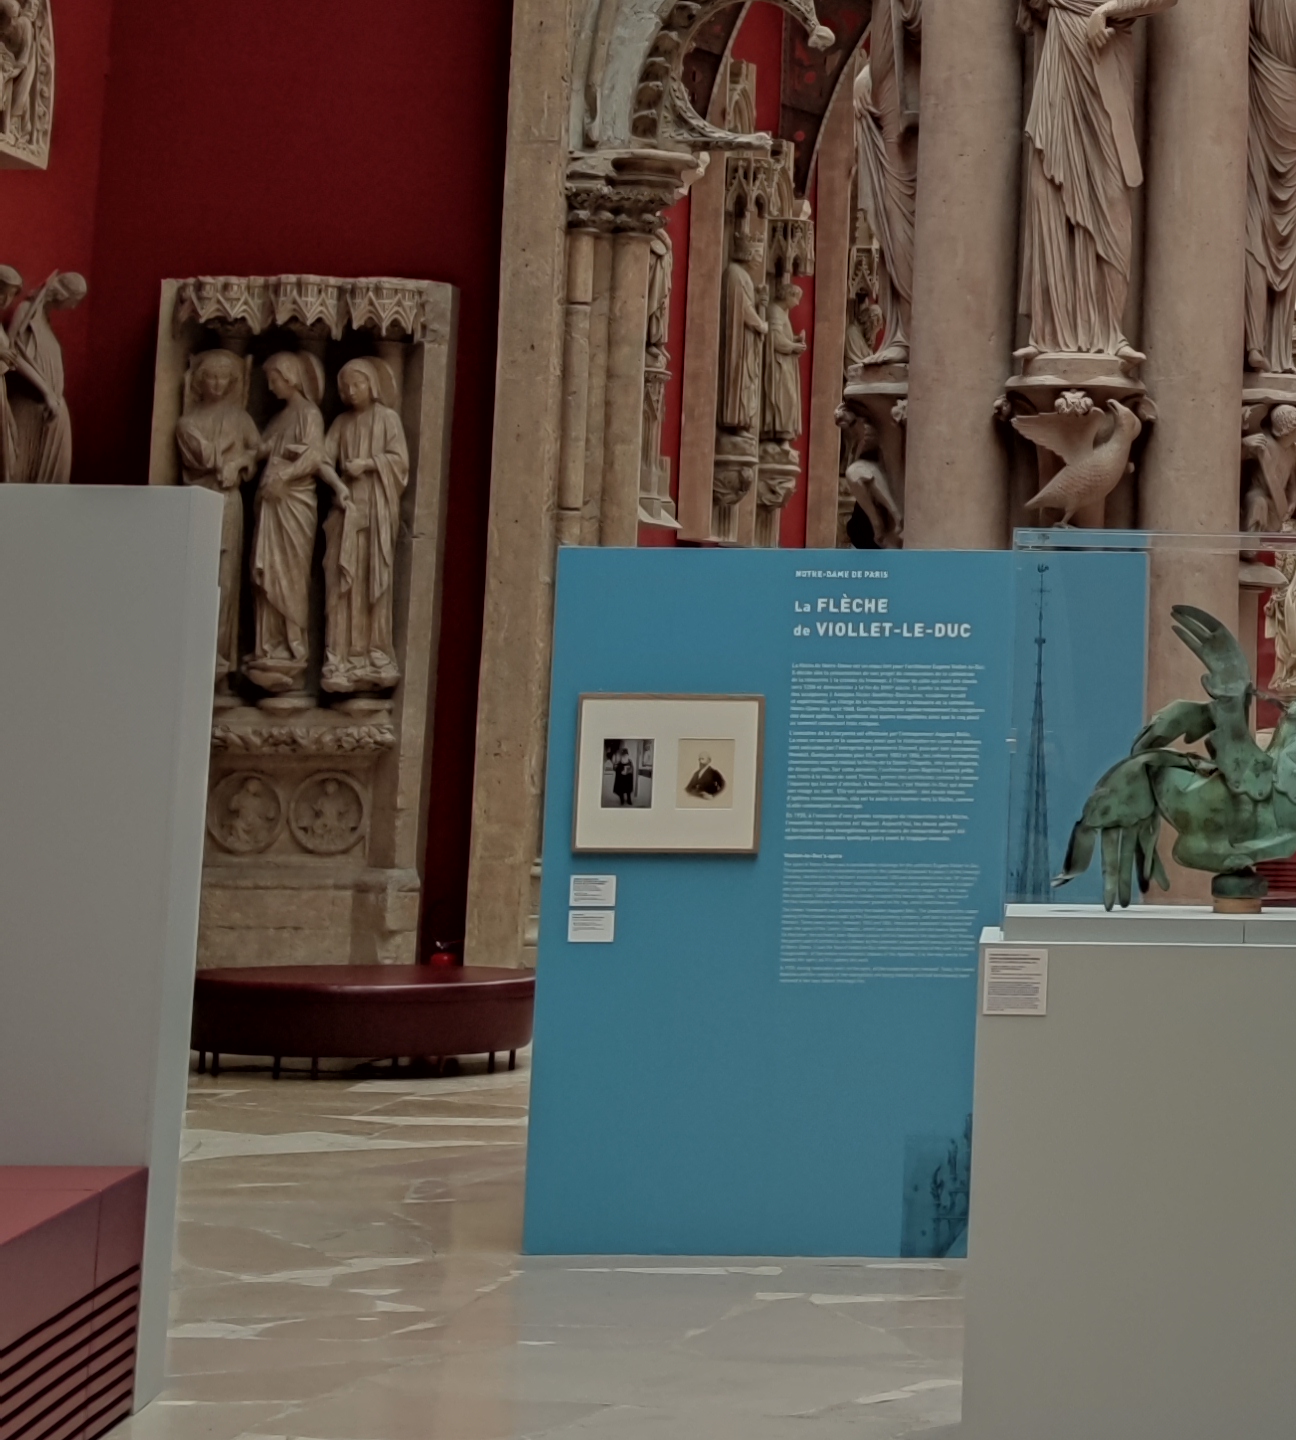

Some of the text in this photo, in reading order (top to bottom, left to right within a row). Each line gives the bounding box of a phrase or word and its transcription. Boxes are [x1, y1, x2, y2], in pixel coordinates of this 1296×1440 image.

[795, 570, 889, 579] NOTRE-DAME DE PARIS
[794, 593, 889, 614] La FLÈCHE
[793, 622, 972, 638] de VIOLLET-LE-DUC
